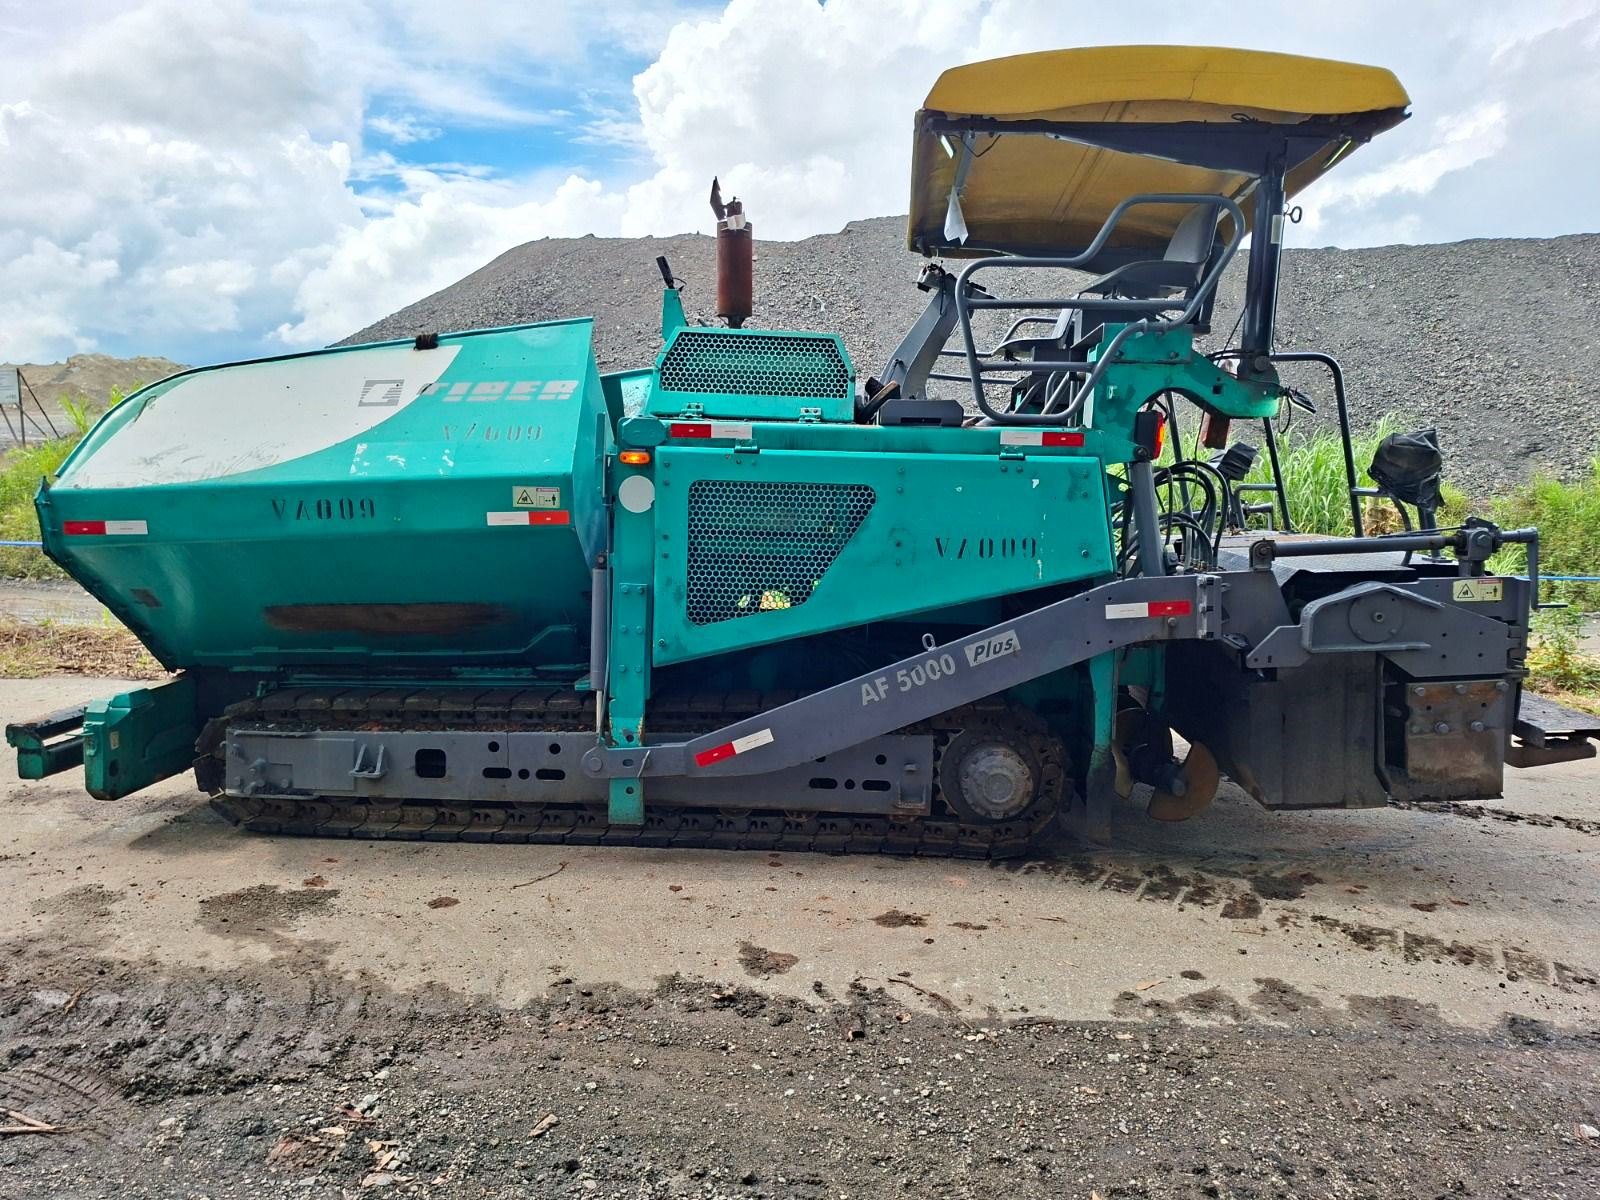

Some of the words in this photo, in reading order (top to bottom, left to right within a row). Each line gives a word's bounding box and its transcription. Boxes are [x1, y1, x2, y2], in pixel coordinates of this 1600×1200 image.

[860, 676, 889, 706] AF
[896, 653, 956, 692] 5000
[973, 636, 1014, 663] Plus
